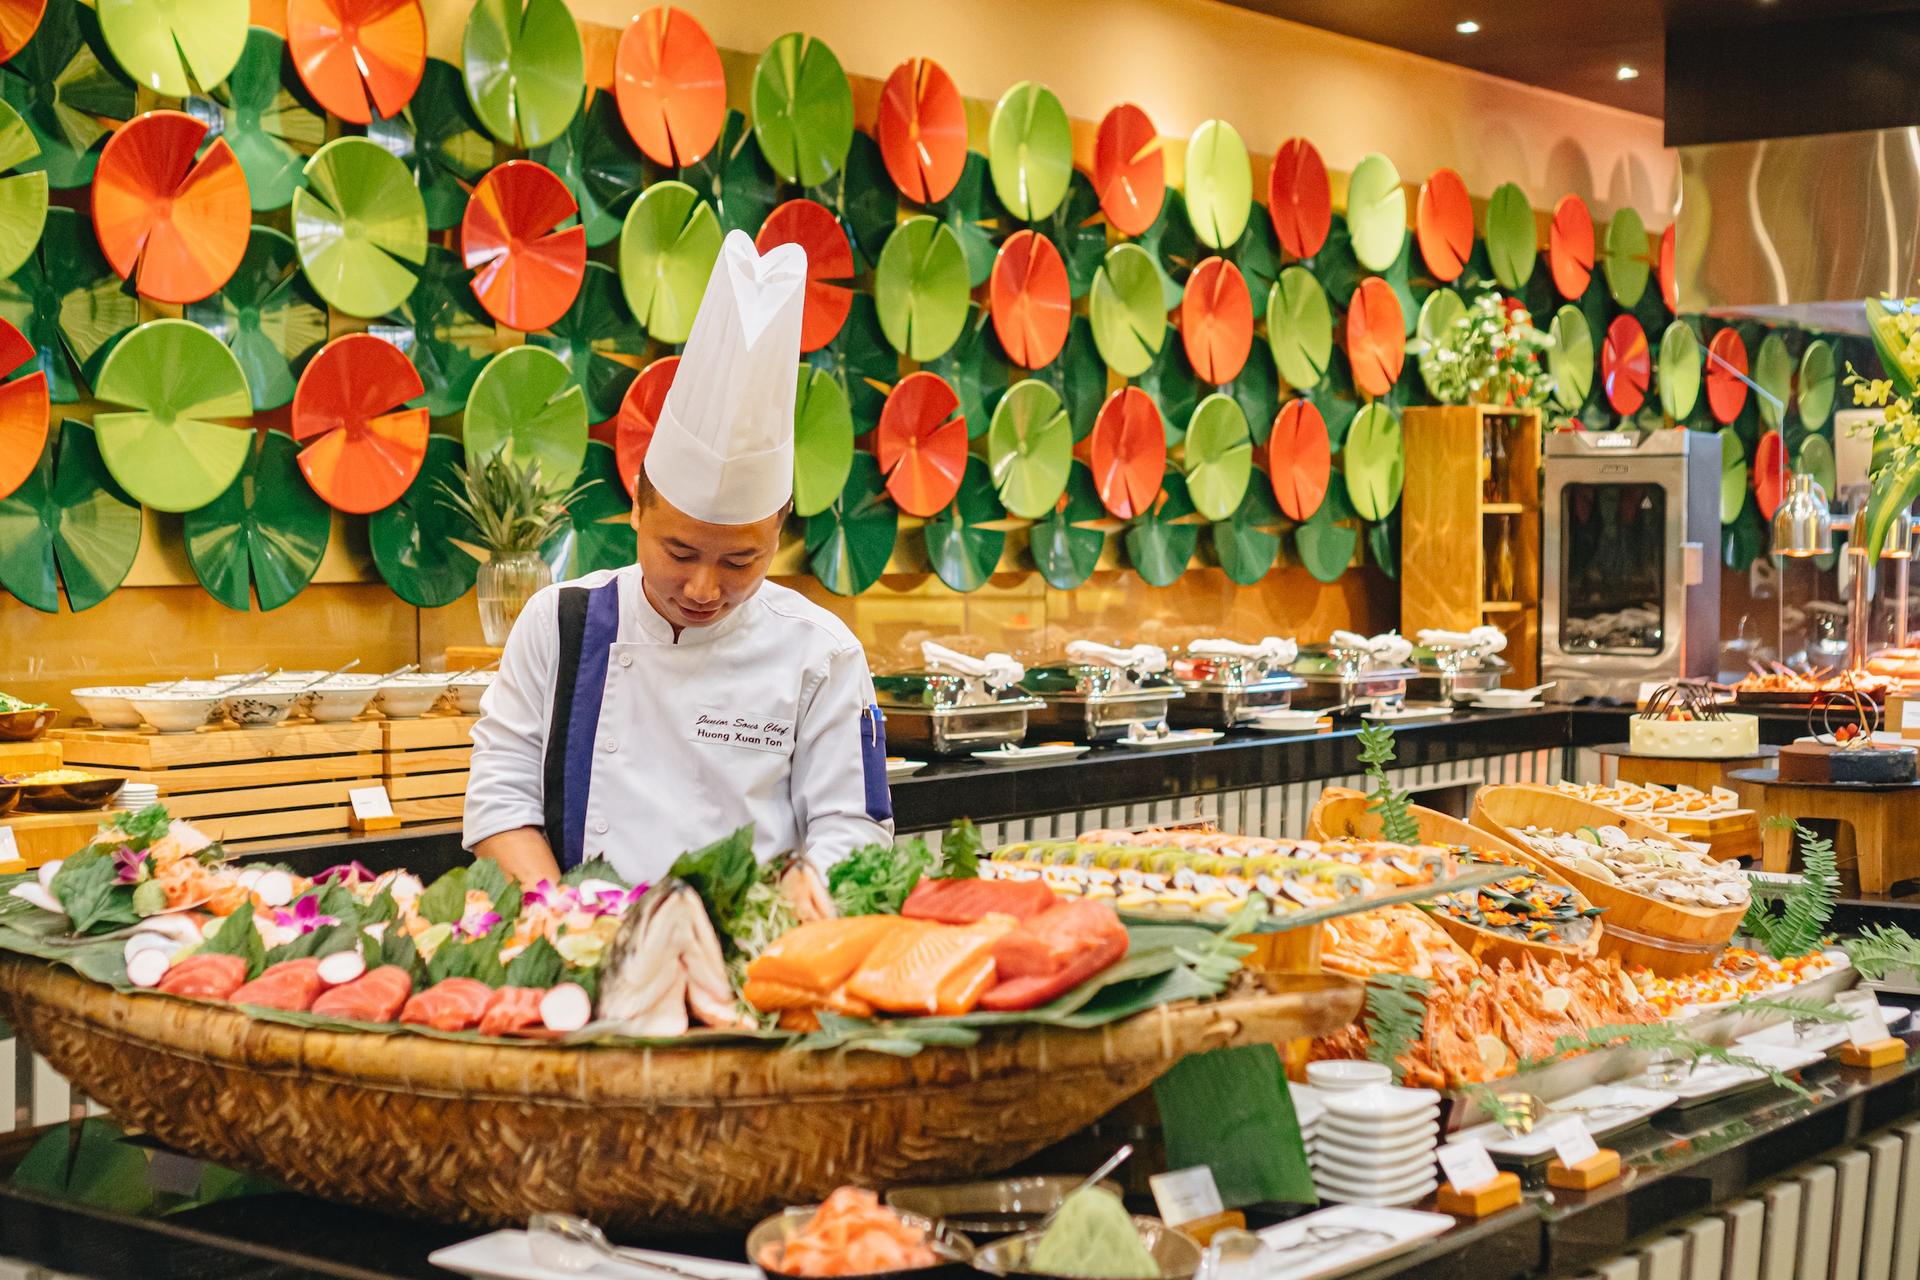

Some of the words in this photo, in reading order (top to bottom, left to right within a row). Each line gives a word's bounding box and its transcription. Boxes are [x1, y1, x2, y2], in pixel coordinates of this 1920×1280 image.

[696, 715, 728, 725] Junior
[733, 718, 759, 730] Sous
[763, 722, 789, 736] Chef
[697, 729, 730, 741] Huong
[735, 733, 761, 744] Xuan
[765, 737, 782, 747] Ton
